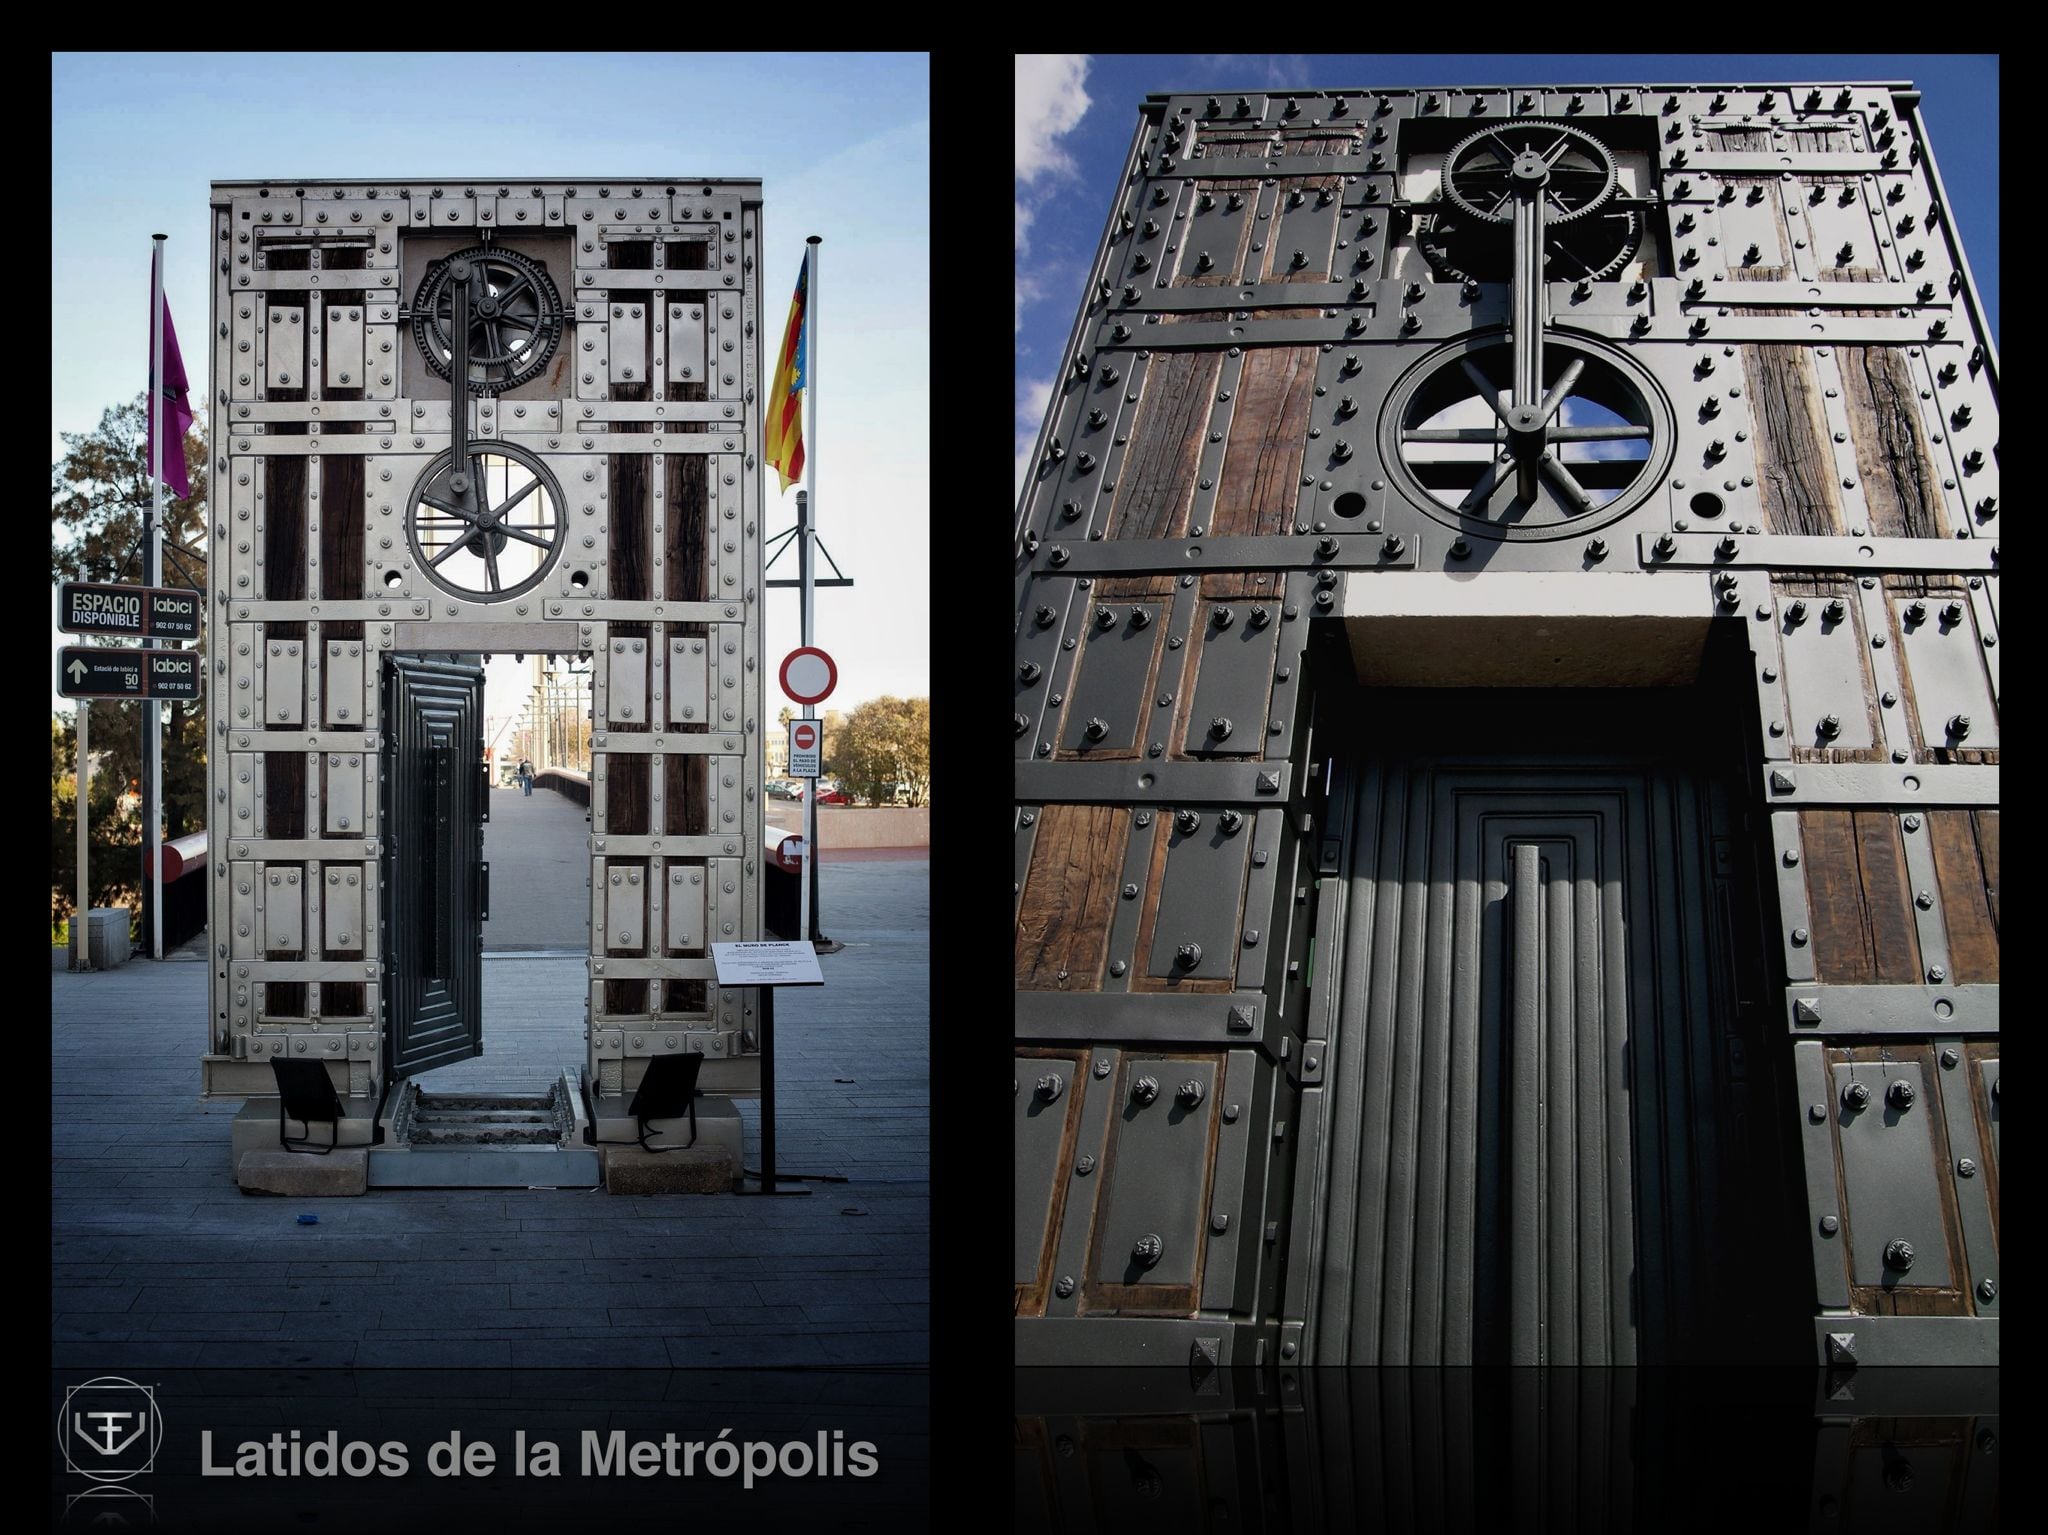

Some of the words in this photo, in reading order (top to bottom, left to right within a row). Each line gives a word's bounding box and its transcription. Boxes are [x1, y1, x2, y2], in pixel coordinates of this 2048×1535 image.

[72, 593, 140, 614] ESPACIO
[153, 597, 192, 614] labici
[72, 611, 140, 627] DISPONIBLE
[155, 621, 166, 629] 902
[153, 658, 191, 673] labici
[125, 673, 139, 685] 50
